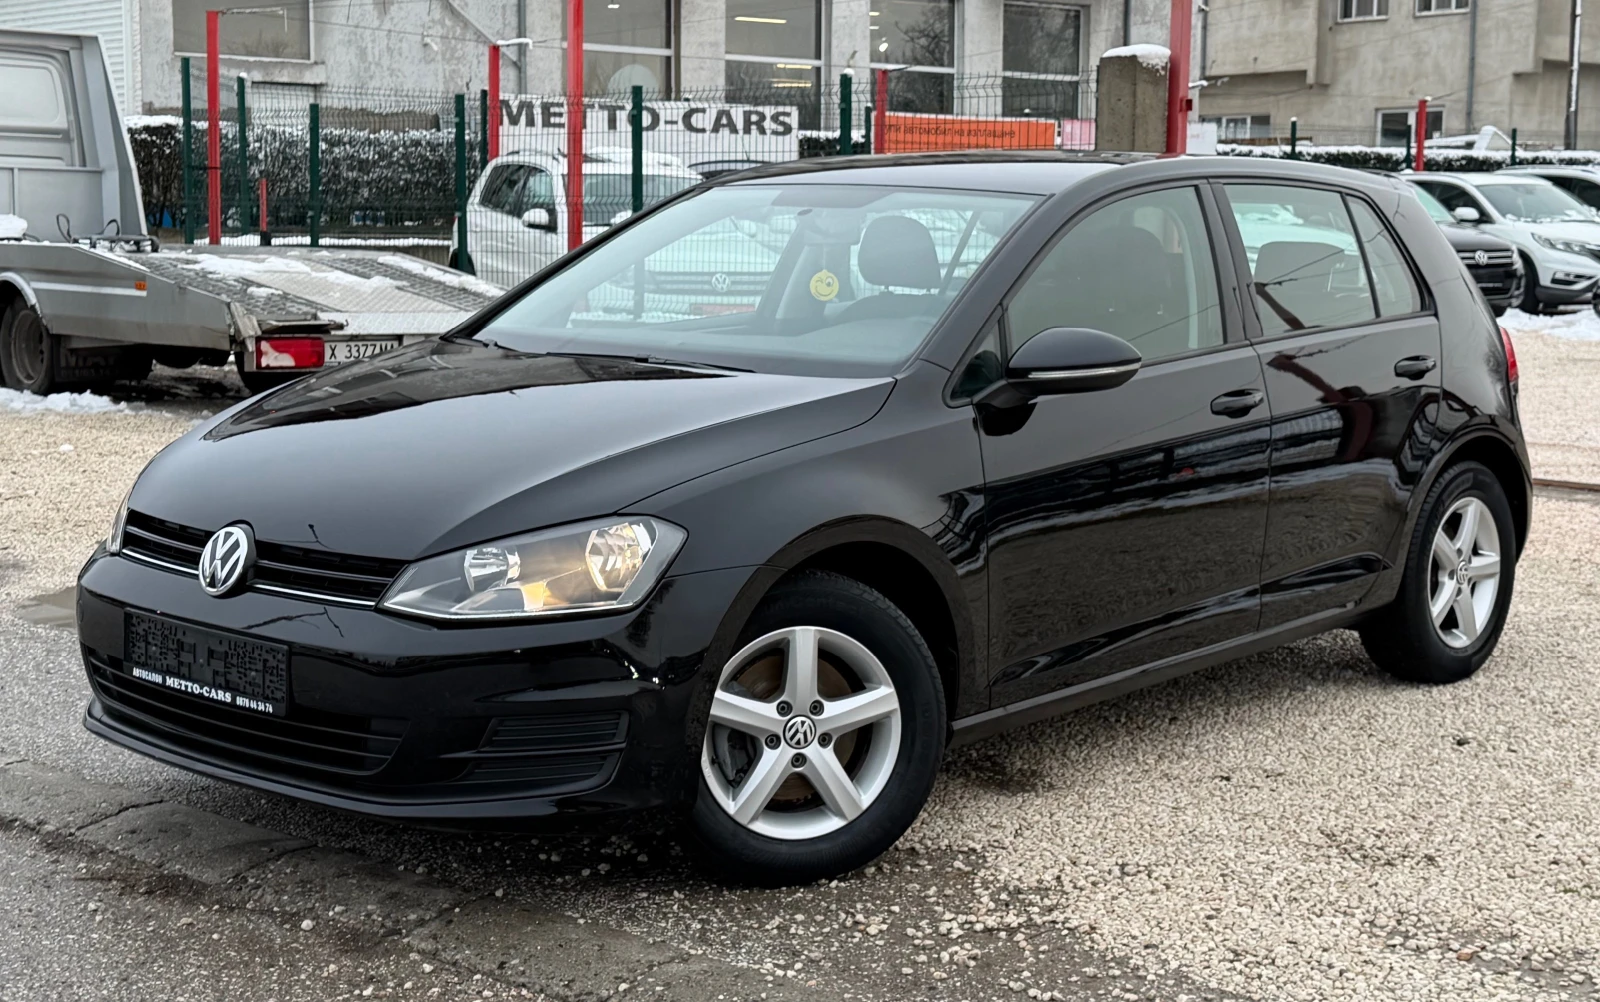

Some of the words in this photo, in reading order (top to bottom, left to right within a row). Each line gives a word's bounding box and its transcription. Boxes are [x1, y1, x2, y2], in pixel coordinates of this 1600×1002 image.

[904, 125, 952, 137] автомобил
[954, 127, 964, 137] на
[329, 344, 337, 360] X
[344, 343, 377, 360] 3377
[132, 667, 163, 684] АВТОСАЛОН
[165, 675, 232, 703] METTO-CARS
